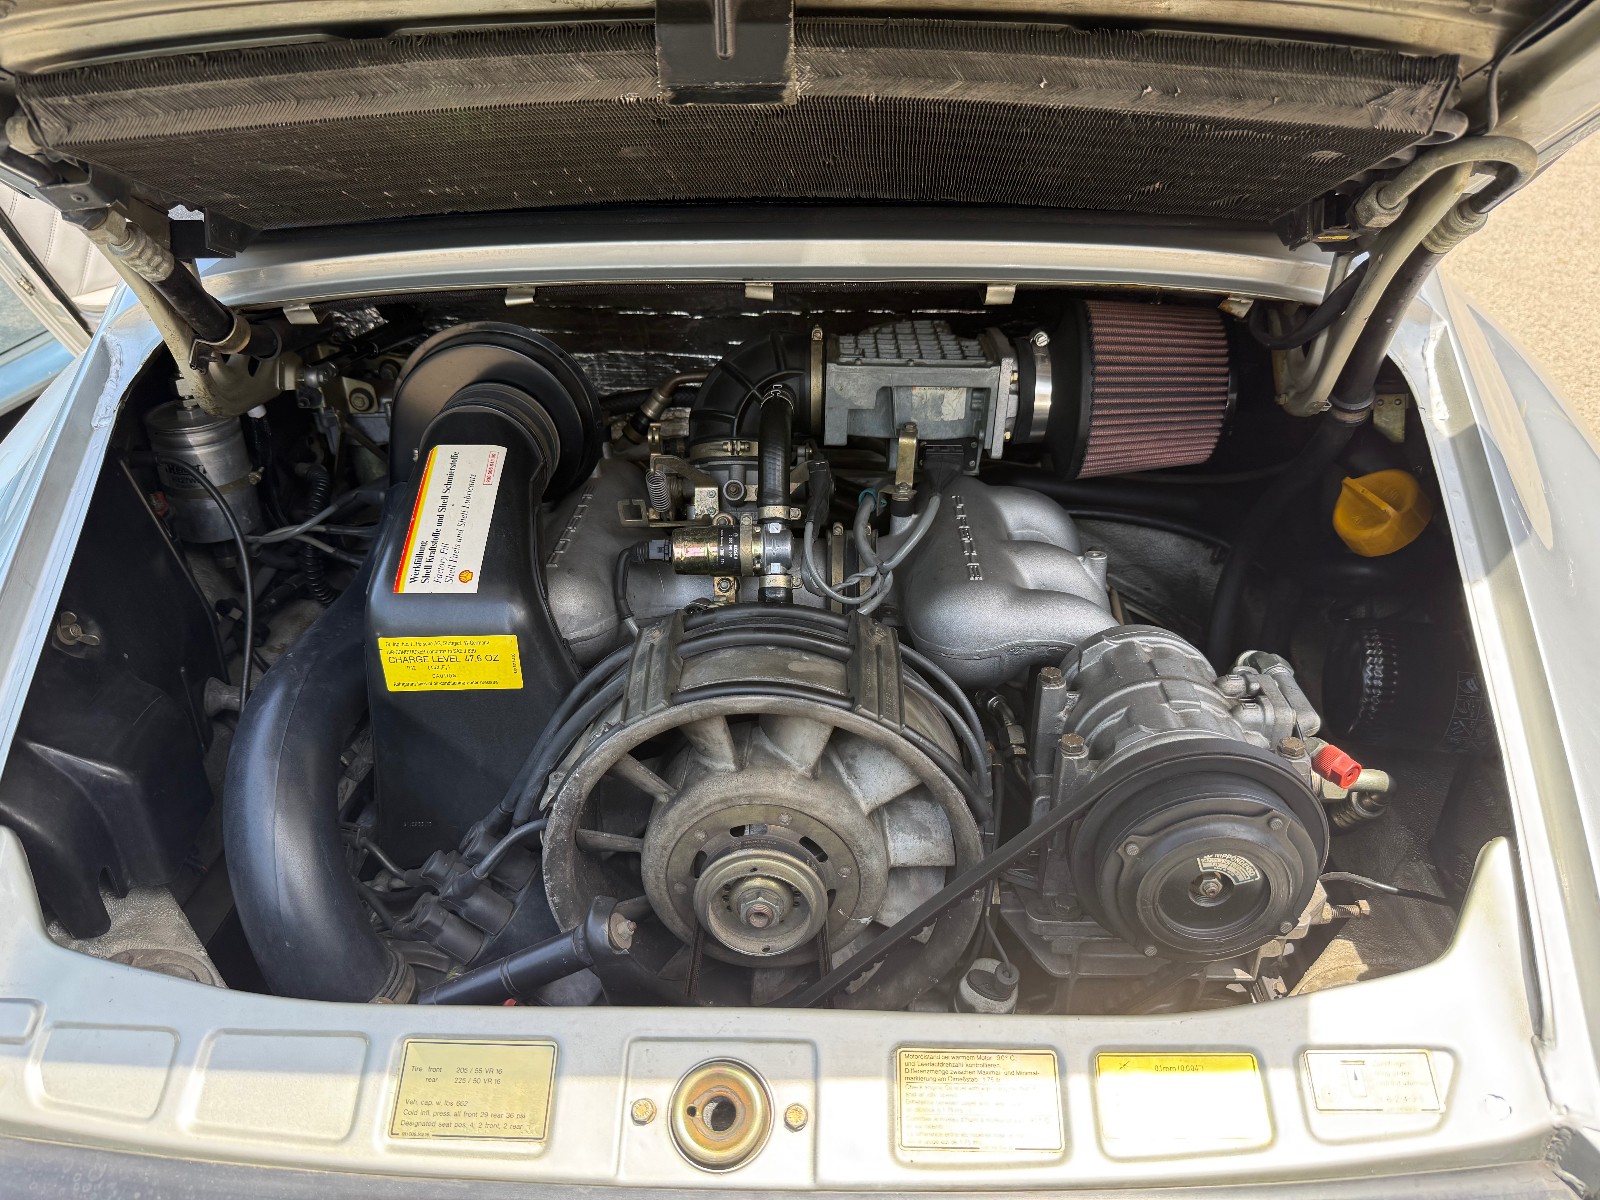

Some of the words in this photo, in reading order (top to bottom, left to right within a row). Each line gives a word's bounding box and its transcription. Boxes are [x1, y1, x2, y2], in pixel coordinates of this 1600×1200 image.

[442, 451, 460, 494] Schmierstoffe
[438, 495, 450, 512] Shell
[436, 514, 445, 527] und
[457, 509, 469, 527] Shell
[454, 528, 464, 543] and
[426, 528, 442, 563] Kraftstoffe
[409, 540, 428, 584] Werkfüllung
[420, 565, 432, 584] Shell
[444, 565, 456, 584] Shell
[388, 655, 429, 663] CHARGE
